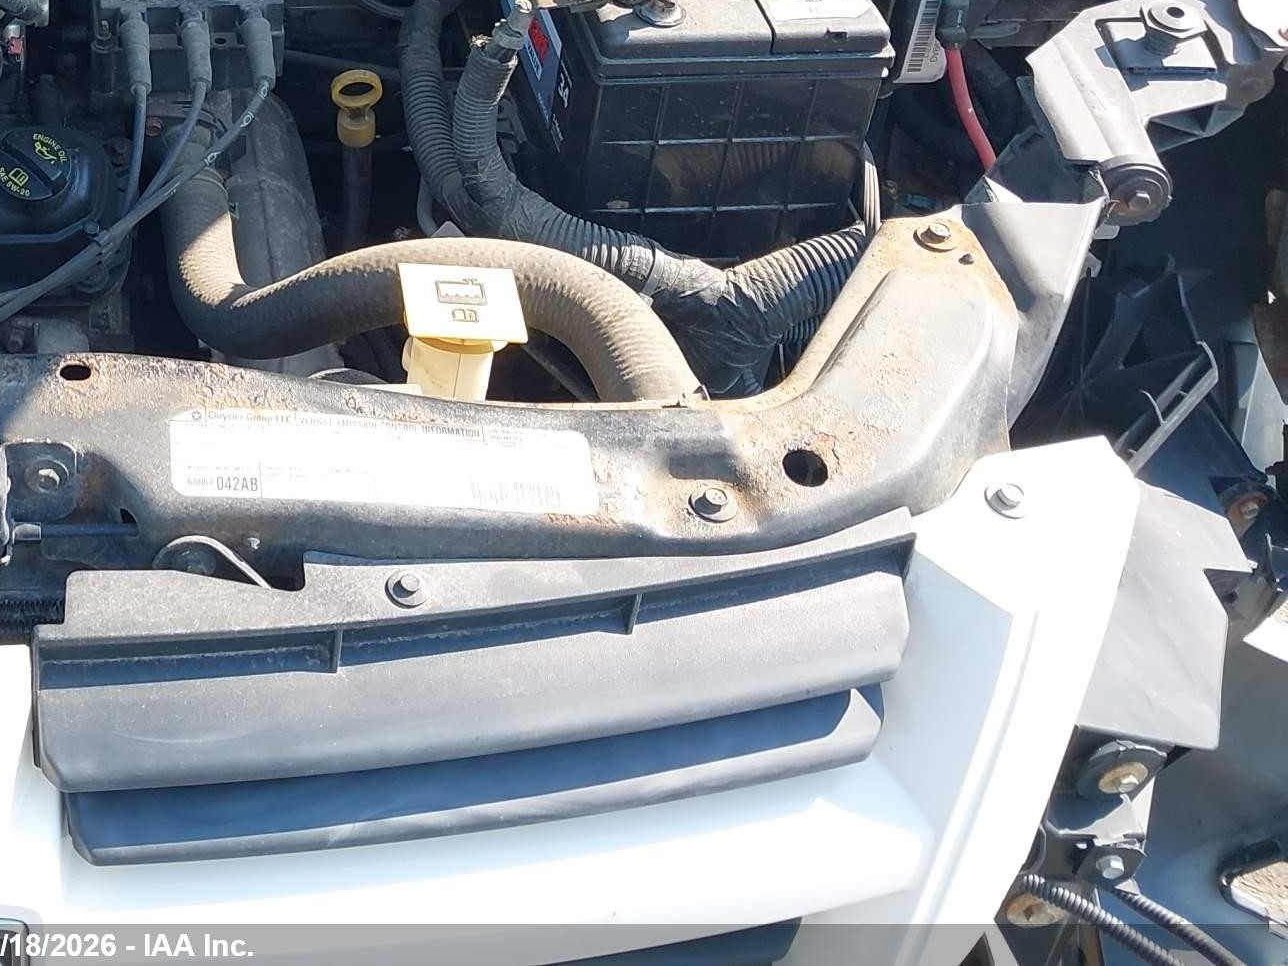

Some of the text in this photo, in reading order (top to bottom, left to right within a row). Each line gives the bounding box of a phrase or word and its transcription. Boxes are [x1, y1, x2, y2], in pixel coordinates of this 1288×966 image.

[32, 133, 68, 164] ENGINE OIL
[6, 180, 31, 197] 5W-20
[421, 424, 481, 439] INFORMATION
[216, 475, 259, 492] 042AB
